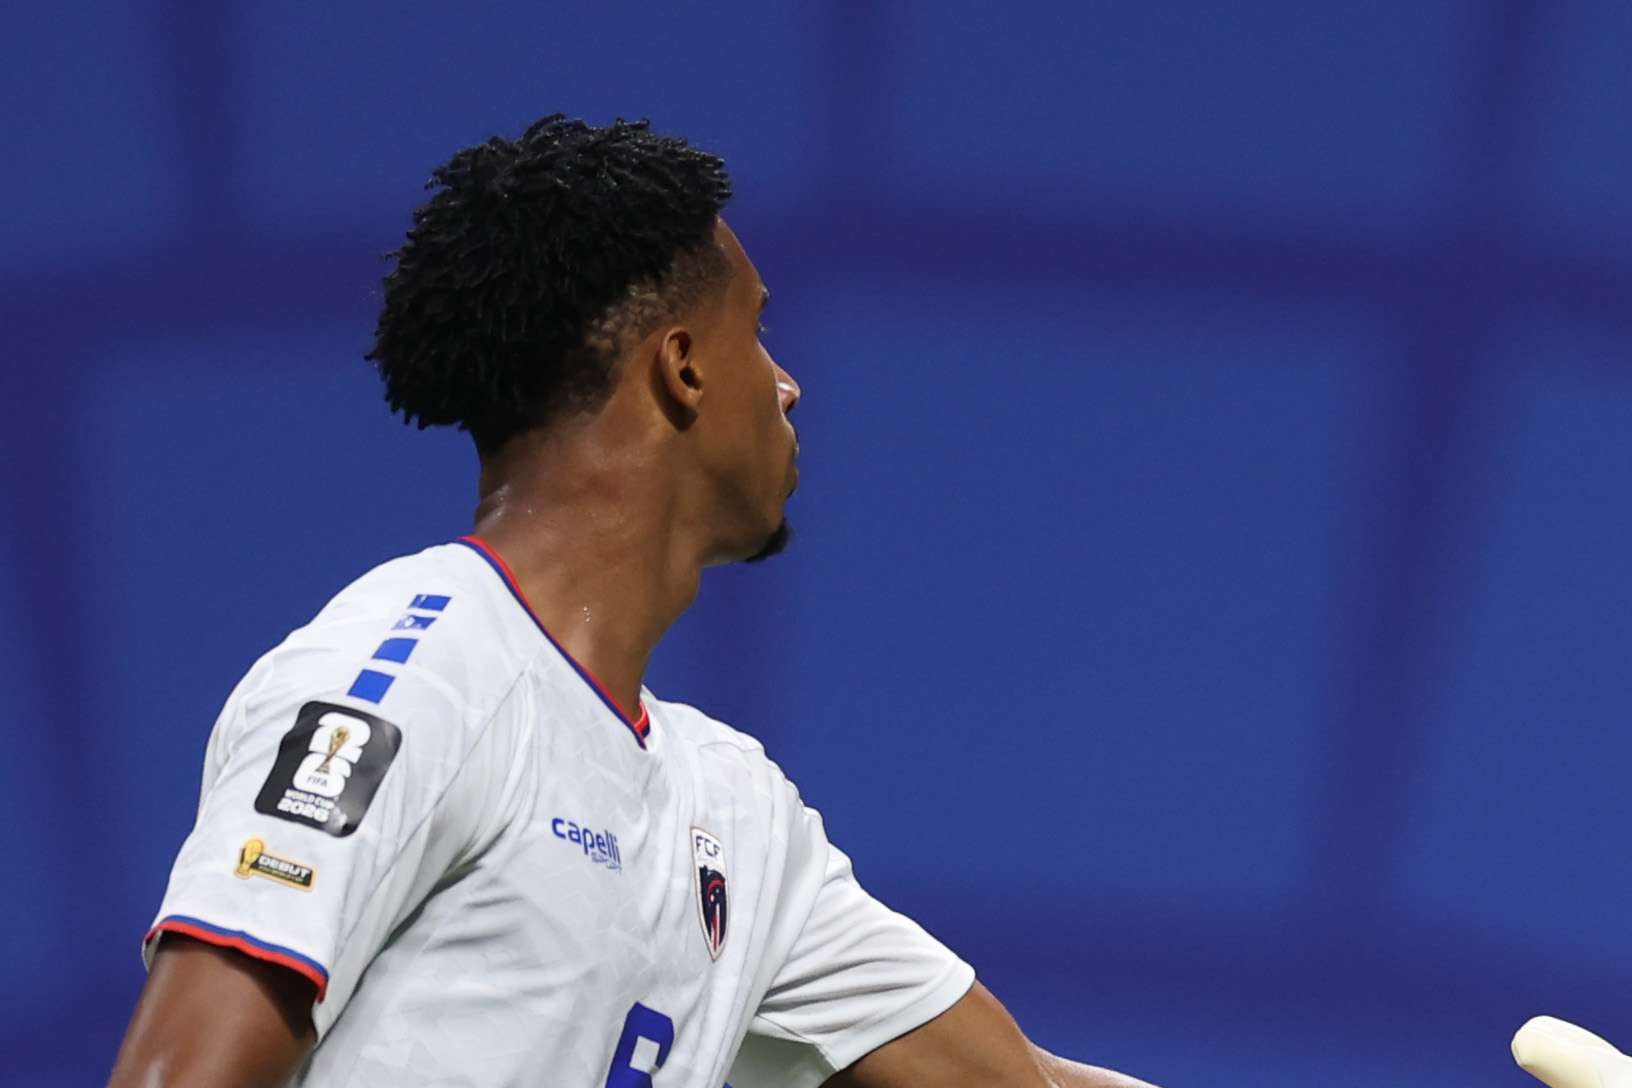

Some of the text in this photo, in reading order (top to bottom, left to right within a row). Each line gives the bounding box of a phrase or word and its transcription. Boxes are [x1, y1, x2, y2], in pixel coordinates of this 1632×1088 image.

[277, 798, 330, 822] 2026
[551, 817, 621, 865] capelli
[696, 836, 721, 858] FCF
[258, 855, 311, 878] DEBUT
